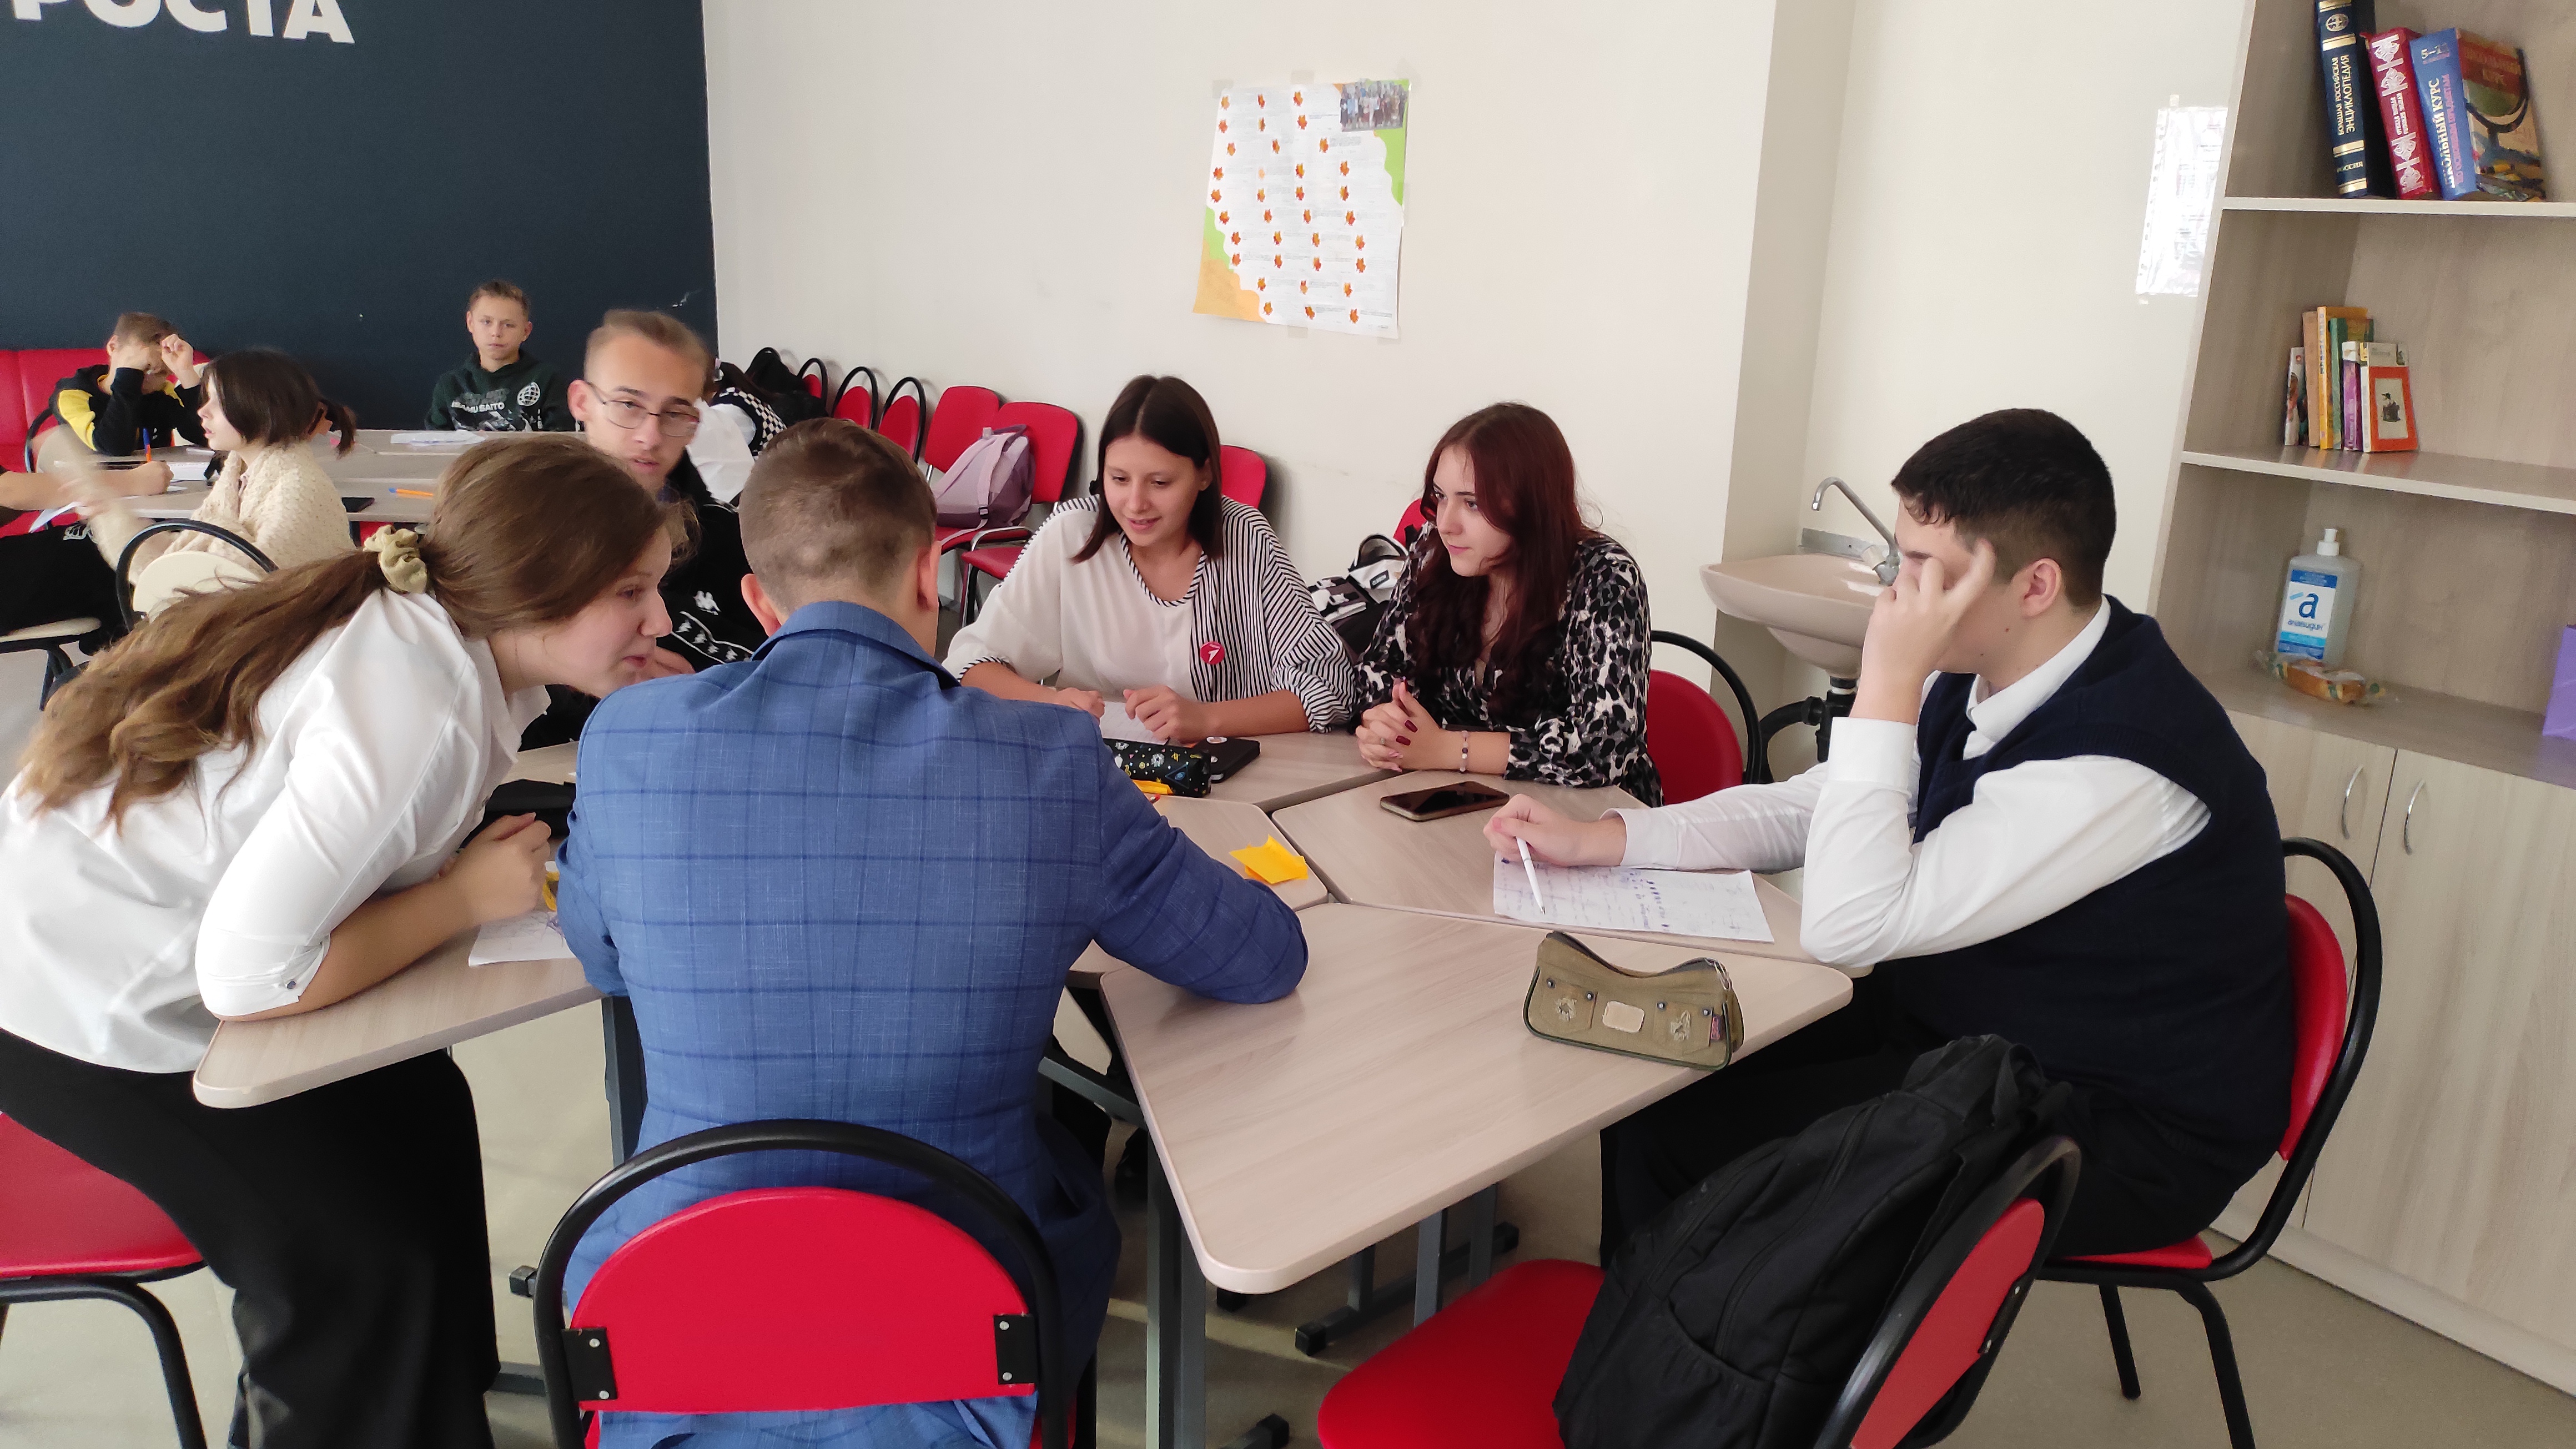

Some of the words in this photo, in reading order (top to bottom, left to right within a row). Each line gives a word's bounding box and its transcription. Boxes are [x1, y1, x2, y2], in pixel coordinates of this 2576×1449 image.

[2332, 57, 2342, 102] РОССИЙСКАЯ
[2340, 54, 2356, 134] ЭНЦИКЛОПЕДИЯ
[2428, 78, 2444, 112] КУРС
[2335, 103, 2346, 136] БОЛЬШАЯ
[2433, 112, 2456, 189] ШКОЛЬНЫЙ
[479, 401, 505, 412] SAITO
